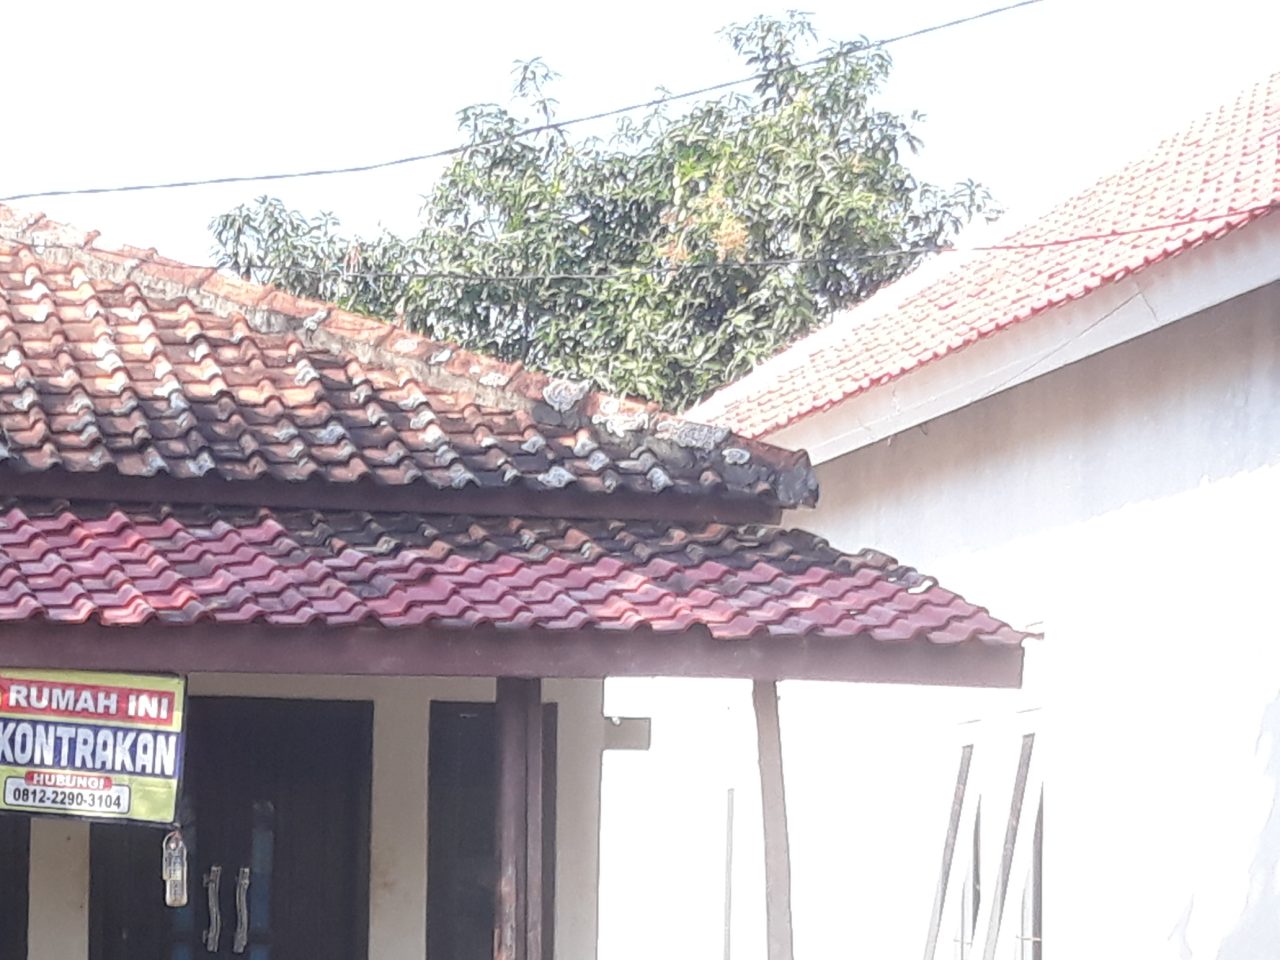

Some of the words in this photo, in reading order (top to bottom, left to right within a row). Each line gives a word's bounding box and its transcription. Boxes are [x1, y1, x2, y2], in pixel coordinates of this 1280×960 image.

[8, 684, 117, 714] RUMAH
[127, 694, 168, 719] INI
[32, 773, 105, 790] HUBUNGI
[13, 787, 121, 809] 0812-2290-3104
